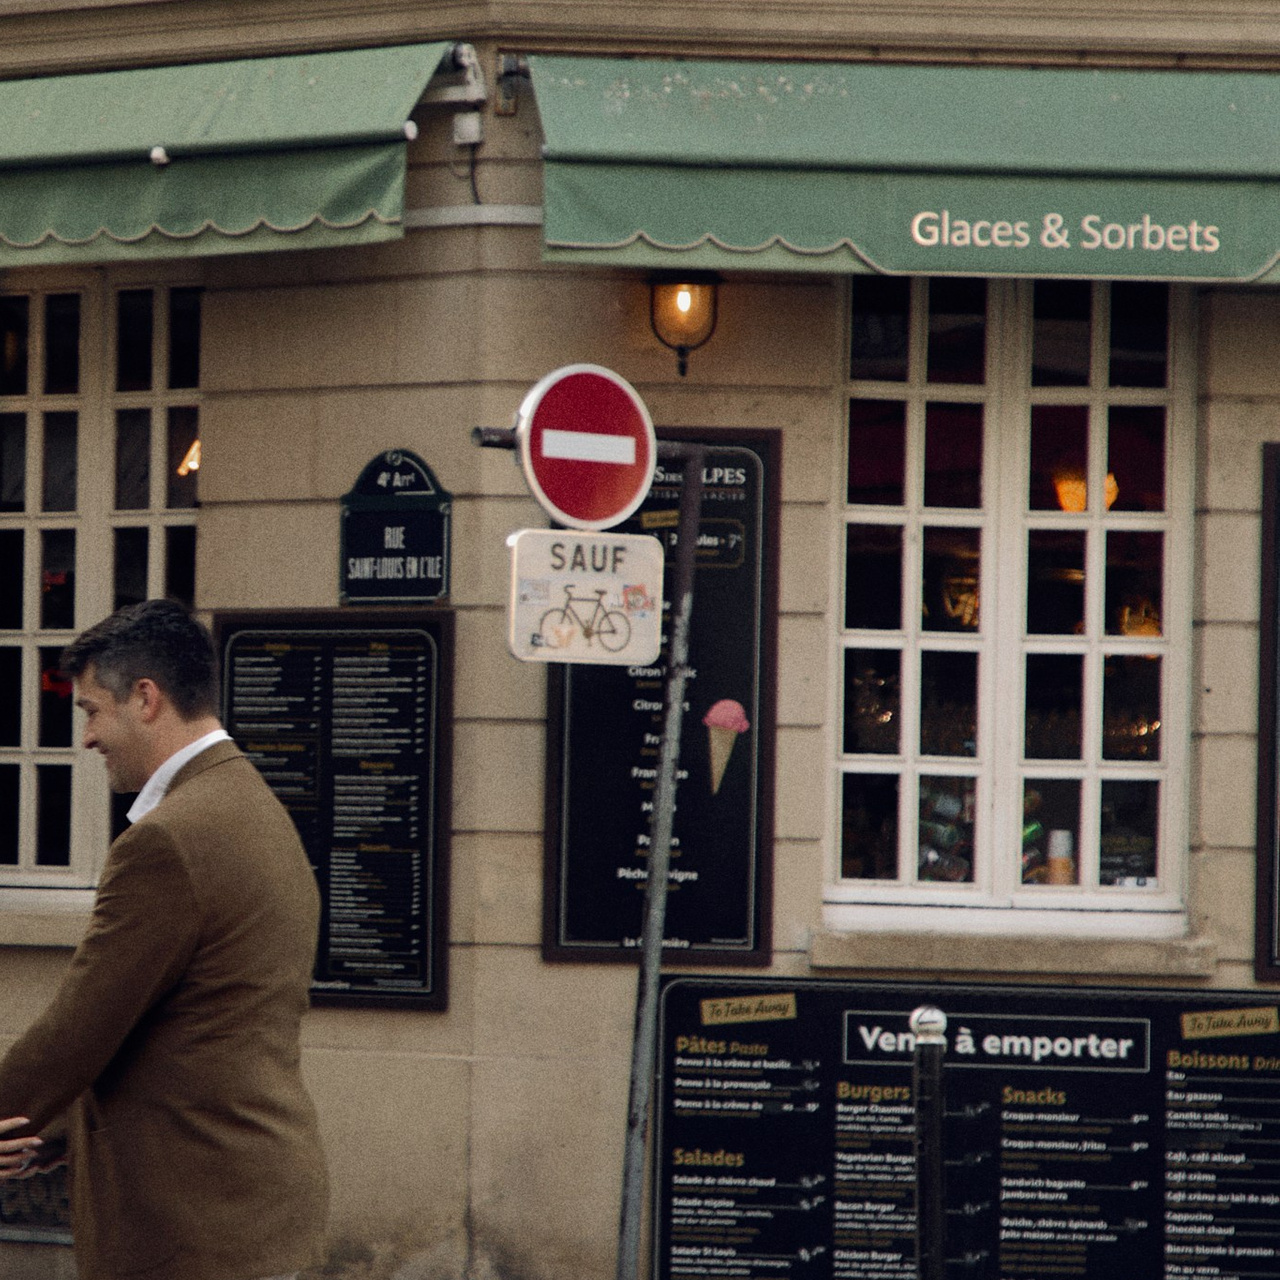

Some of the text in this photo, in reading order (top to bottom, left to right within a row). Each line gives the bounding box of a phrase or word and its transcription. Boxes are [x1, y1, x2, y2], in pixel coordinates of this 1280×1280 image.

[910, 209, 1220, 252] Glaces & Sorbets
[384, 526, 406, 549] RUE
[406, 557, 418, 579] EN
[550, 542, 626, 573] SAUF
[675, 1035, 727, 1054] Pâtes
[954, 1026, 977, 1055] à
[982, 1034, 1134, 1062] emporter
[1167, 1049, 1250, 1070] Boissons
[836, 1081, 911, 1103] Burgers
[1001, 1085, 1067, 1105] Snacks
[673, 1148, 744, 1167] Salades
